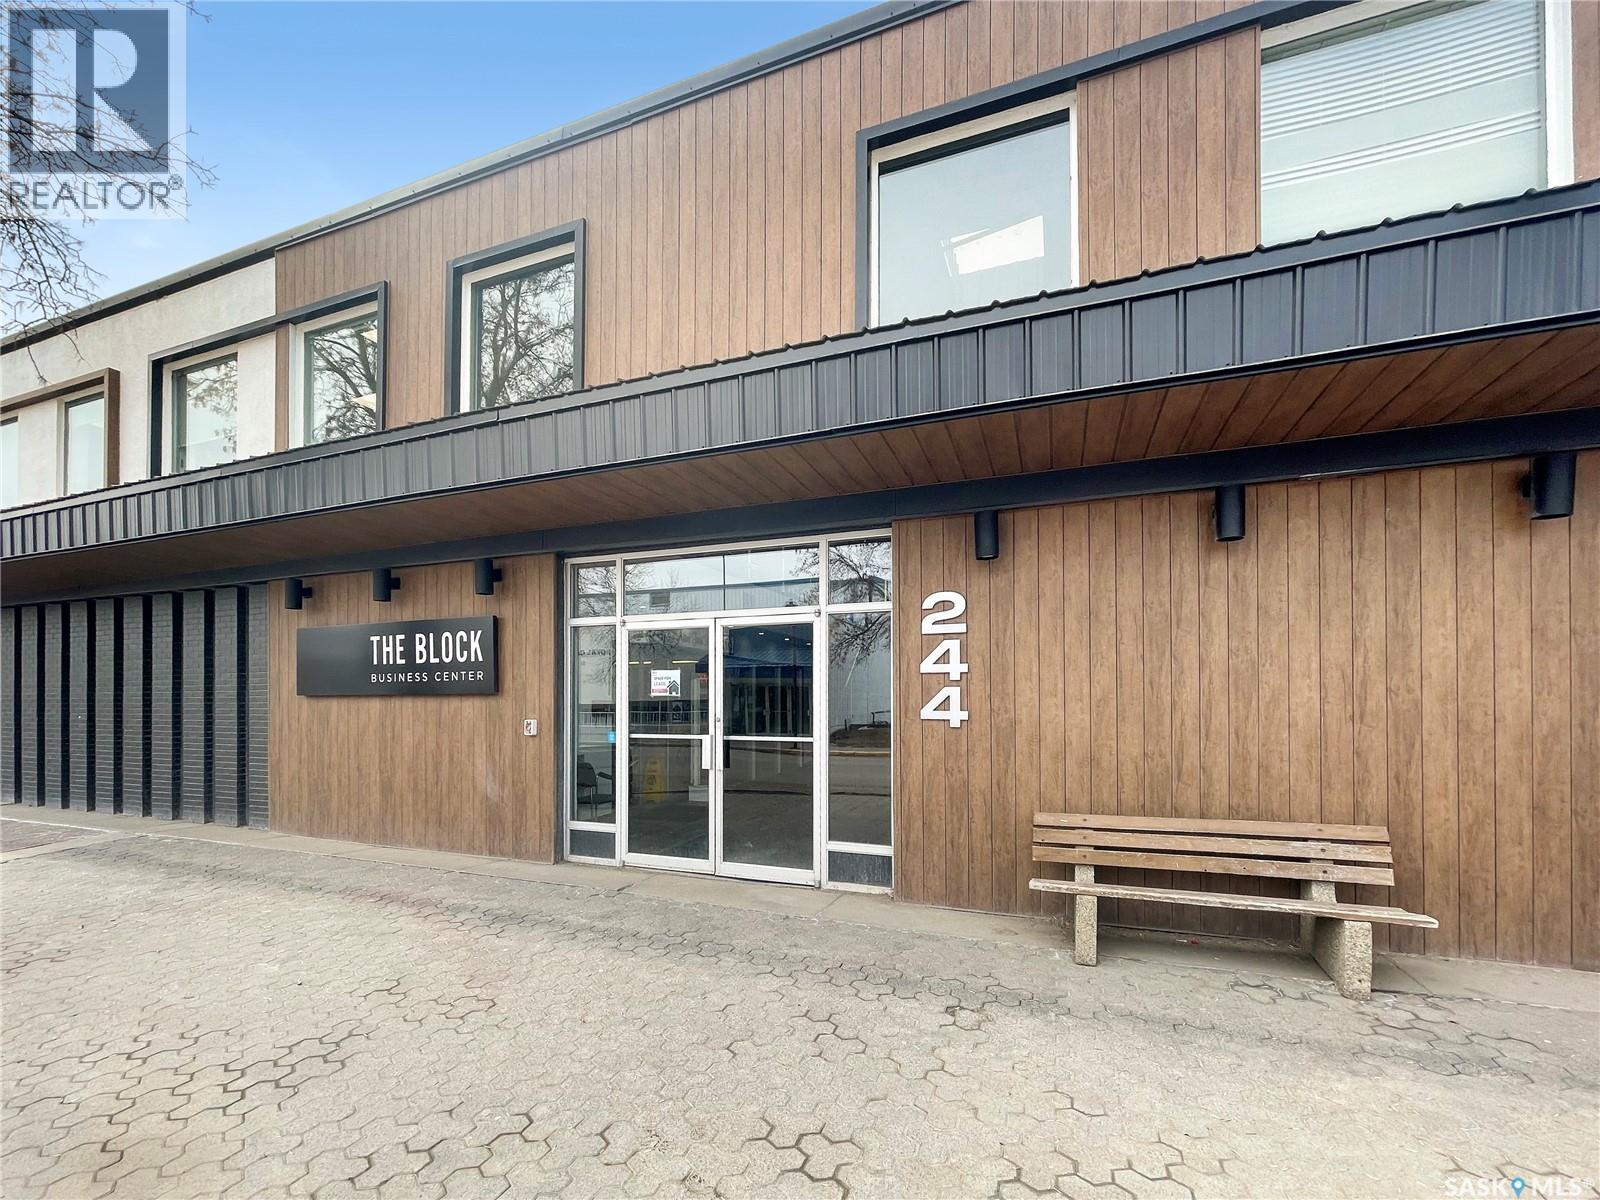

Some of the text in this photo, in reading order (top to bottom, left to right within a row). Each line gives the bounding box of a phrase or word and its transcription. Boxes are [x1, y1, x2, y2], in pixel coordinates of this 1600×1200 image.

[370, 630, 484, 665] THE BLOCK
[919, 591, 969, 728] 244
[370, 670, 485, 683] BUSINESS CENTER
